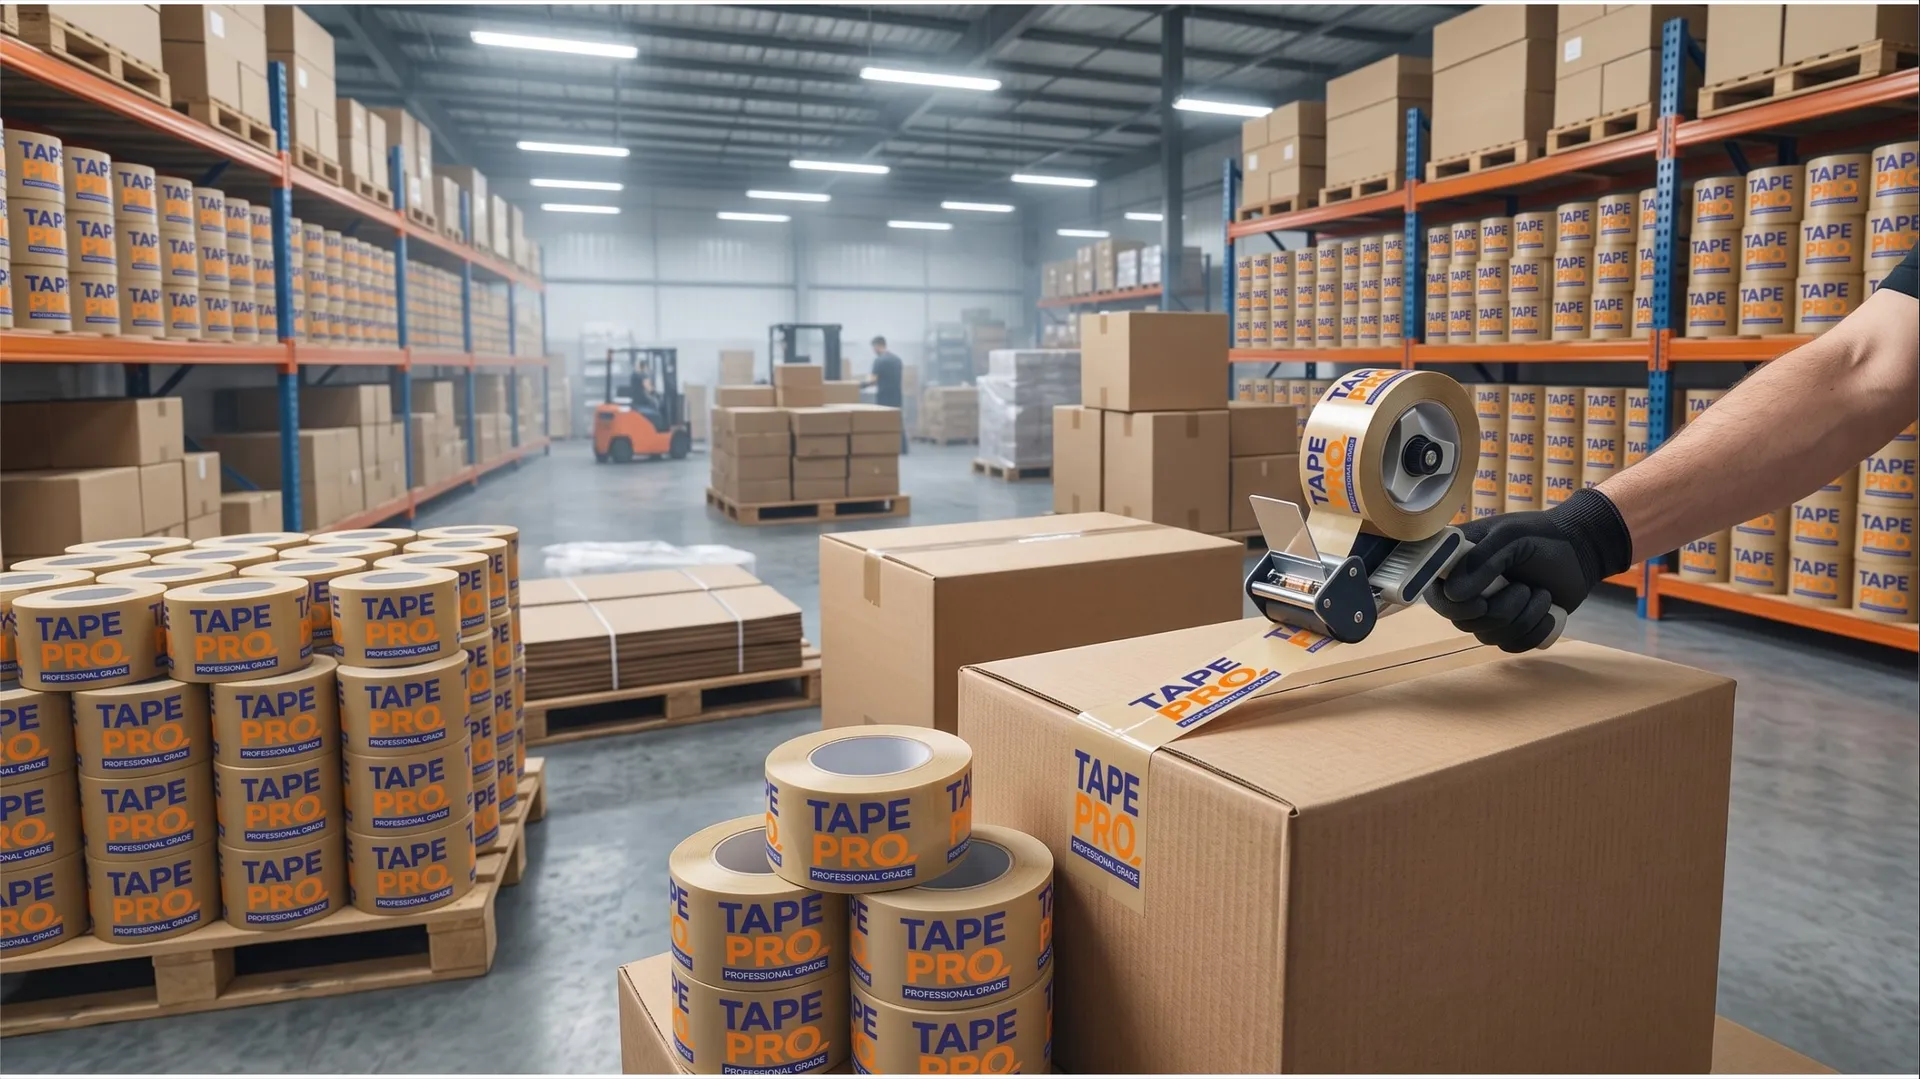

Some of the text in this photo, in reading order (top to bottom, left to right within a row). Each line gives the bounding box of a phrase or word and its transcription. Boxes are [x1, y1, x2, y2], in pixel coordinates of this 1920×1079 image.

[1876, 152, 1918, 172] TAP
[1810, 163, 1859, 183] TAPE
[1750, 175, 1793, 192] TAPE
[1697, 185, 1734, 202] TAPE
[1560, 209, 1590, 222] TAPE
[1600, 202, 1631, 217] TAPE
[1483, 225, 1508, 236] TAPE
[1516, 220, 1543, 231] TAPE
[1805, 224, 1852, 241] TAPE
[1692, 239, 1731, 253] TAPE
[1745, 231, 1787, 248] TAPE
[1556, 256, 1586, 268] TAPE
[1598, 251, 1628, 264] TAPE
[1478, 267, 1500, 278] TAPE
[1511, 264, 1538, 275] TAPE
[1690, 291, 1726, 305] TAPE
[1741, 287, 1784, 302] TAPE
[1801, 283, 1848, 298] TAPE
[1512, 306, 1538, 317] TAPE
[1555, 301, 1583, 313] TAPE
[1594, 298, 1623, 310] TAPE
[1479, 307, 1502, 319] TAPE
[1477, 392, 1500, 402] TAPE
[1511, 393, 1536, 404] TAPE
[1548, 394, 1575, 406] TAPE
[1588, 396, 1616, 408] TAPE
[1509, 433, 1534, 444] TAPE
[1547, 436, 1574, 447] TAPE
[1587, 438, 1614, 450] TAPE
[1307, 436, 1328, 505] TAPE
[1865, 457, 1915, 475] TAPE
[1508, 474, 1533, 485] TAPE
[1795, 505, 1840, 523] TAPE
[1862, 514, 1912, 533] TAPE
[1734, 548, 1775, 565] TAPE
[1793, 558, 1838, 577] TAPE
[1860, 570, 1909, 591] TAPE
[362, 593, 435, 620] TAPE
[36, 611, 122, 642] TAPE
[190, 604, 272, 633] TAPE
[1128, 657, 1241, 709] TAPE
[235, 686, 315, 719] TAPE
[365, 679, 440, 709] TAPE
[96, 695, 183, 729] TAPE
[369, 757, 445, 790] TAPE
[241, 768, 320, 801] TAPE
[1075, 749, 1139, 817] TAPE
[101, 778, 186, 813] TAPE
[807, 798, 910, 833] TAPE
[372, 838, 447, 869] TAPE
[242, 849, 323, 883] TAPE
[107, 860, 193, 896] TAPE
[812, 868, 913, 882] PROFESSIONAL GRADE
[718, 893, 823, 934] TAPE
[901, 911, 1005, 951] TAPE
[725, 959, 826, 980] PROFESSIONAL GRADE
[904, 989, 974, 999] PROFESSIONAL
[719, 990, 822, 1031] TAPE
[913, 1008, 1017, 1054] TAPE
[795, 1055, 825, 1072] GRADE
